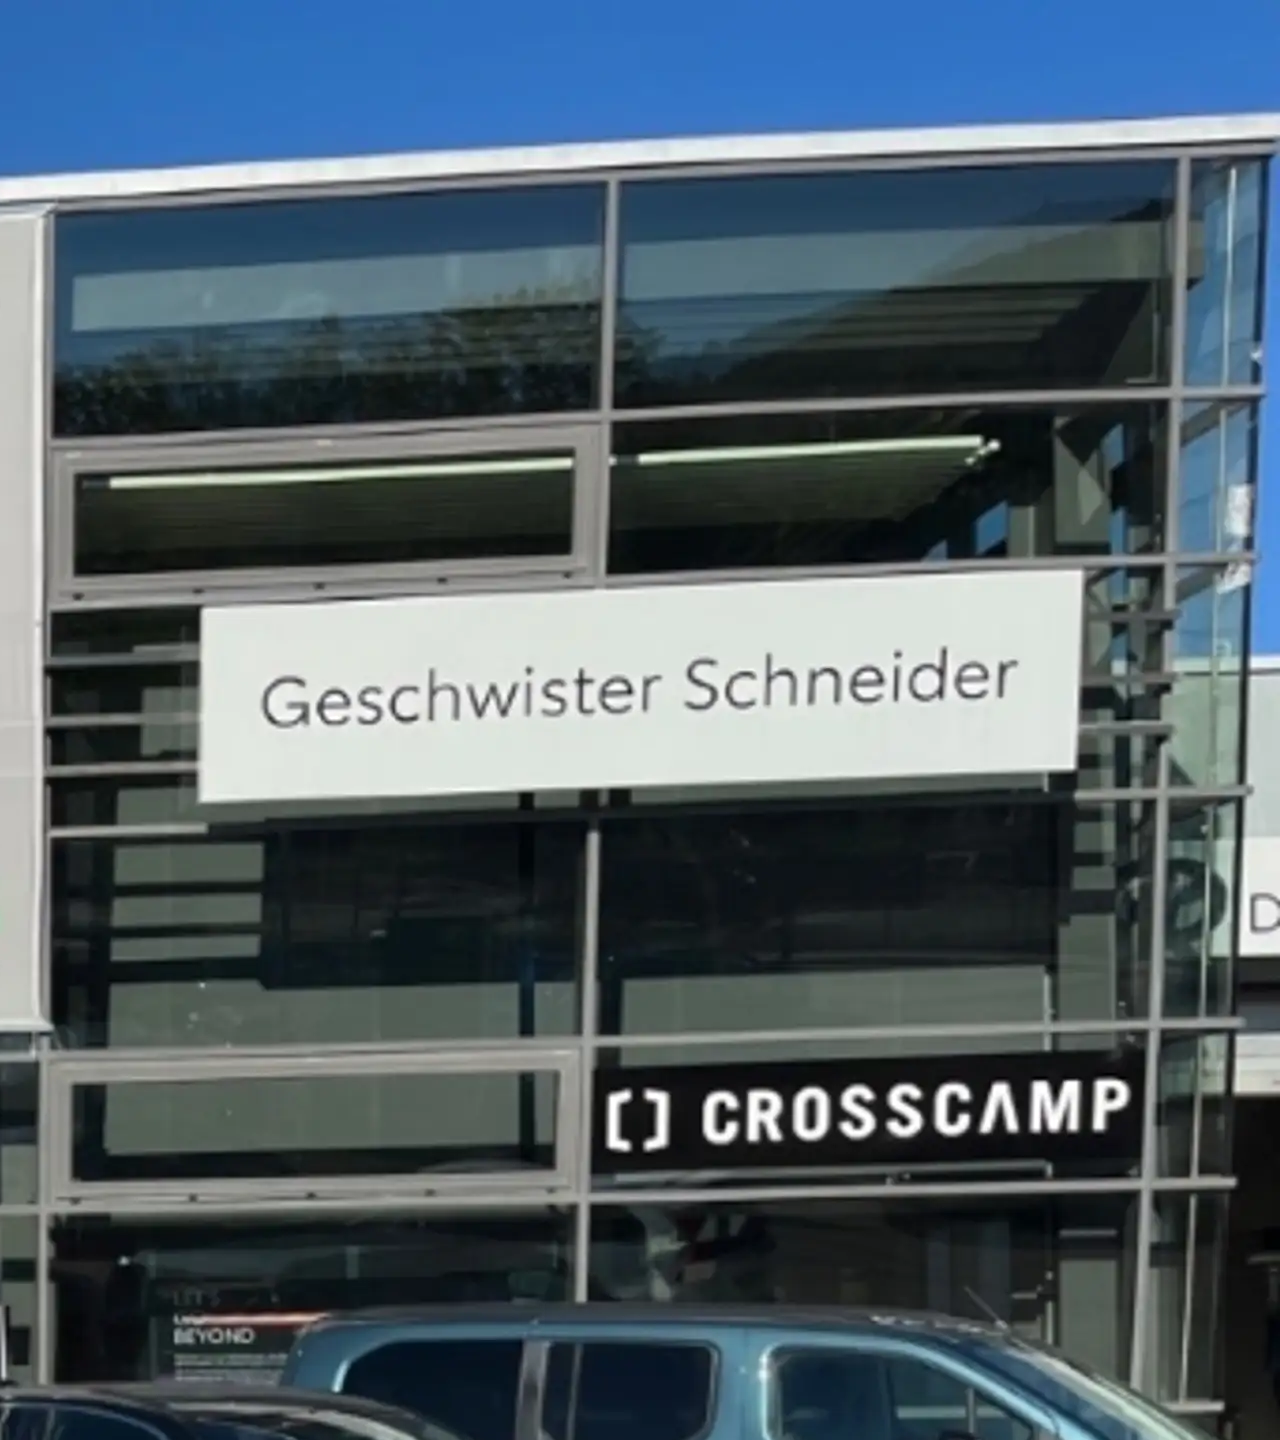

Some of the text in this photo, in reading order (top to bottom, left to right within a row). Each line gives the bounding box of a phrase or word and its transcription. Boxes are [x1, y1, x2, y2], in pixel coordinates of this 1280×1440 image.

[259, 646, 1019, 729] Geschwister Schneider
[701, 1078, 1132, 1145] CROSSCAMP
